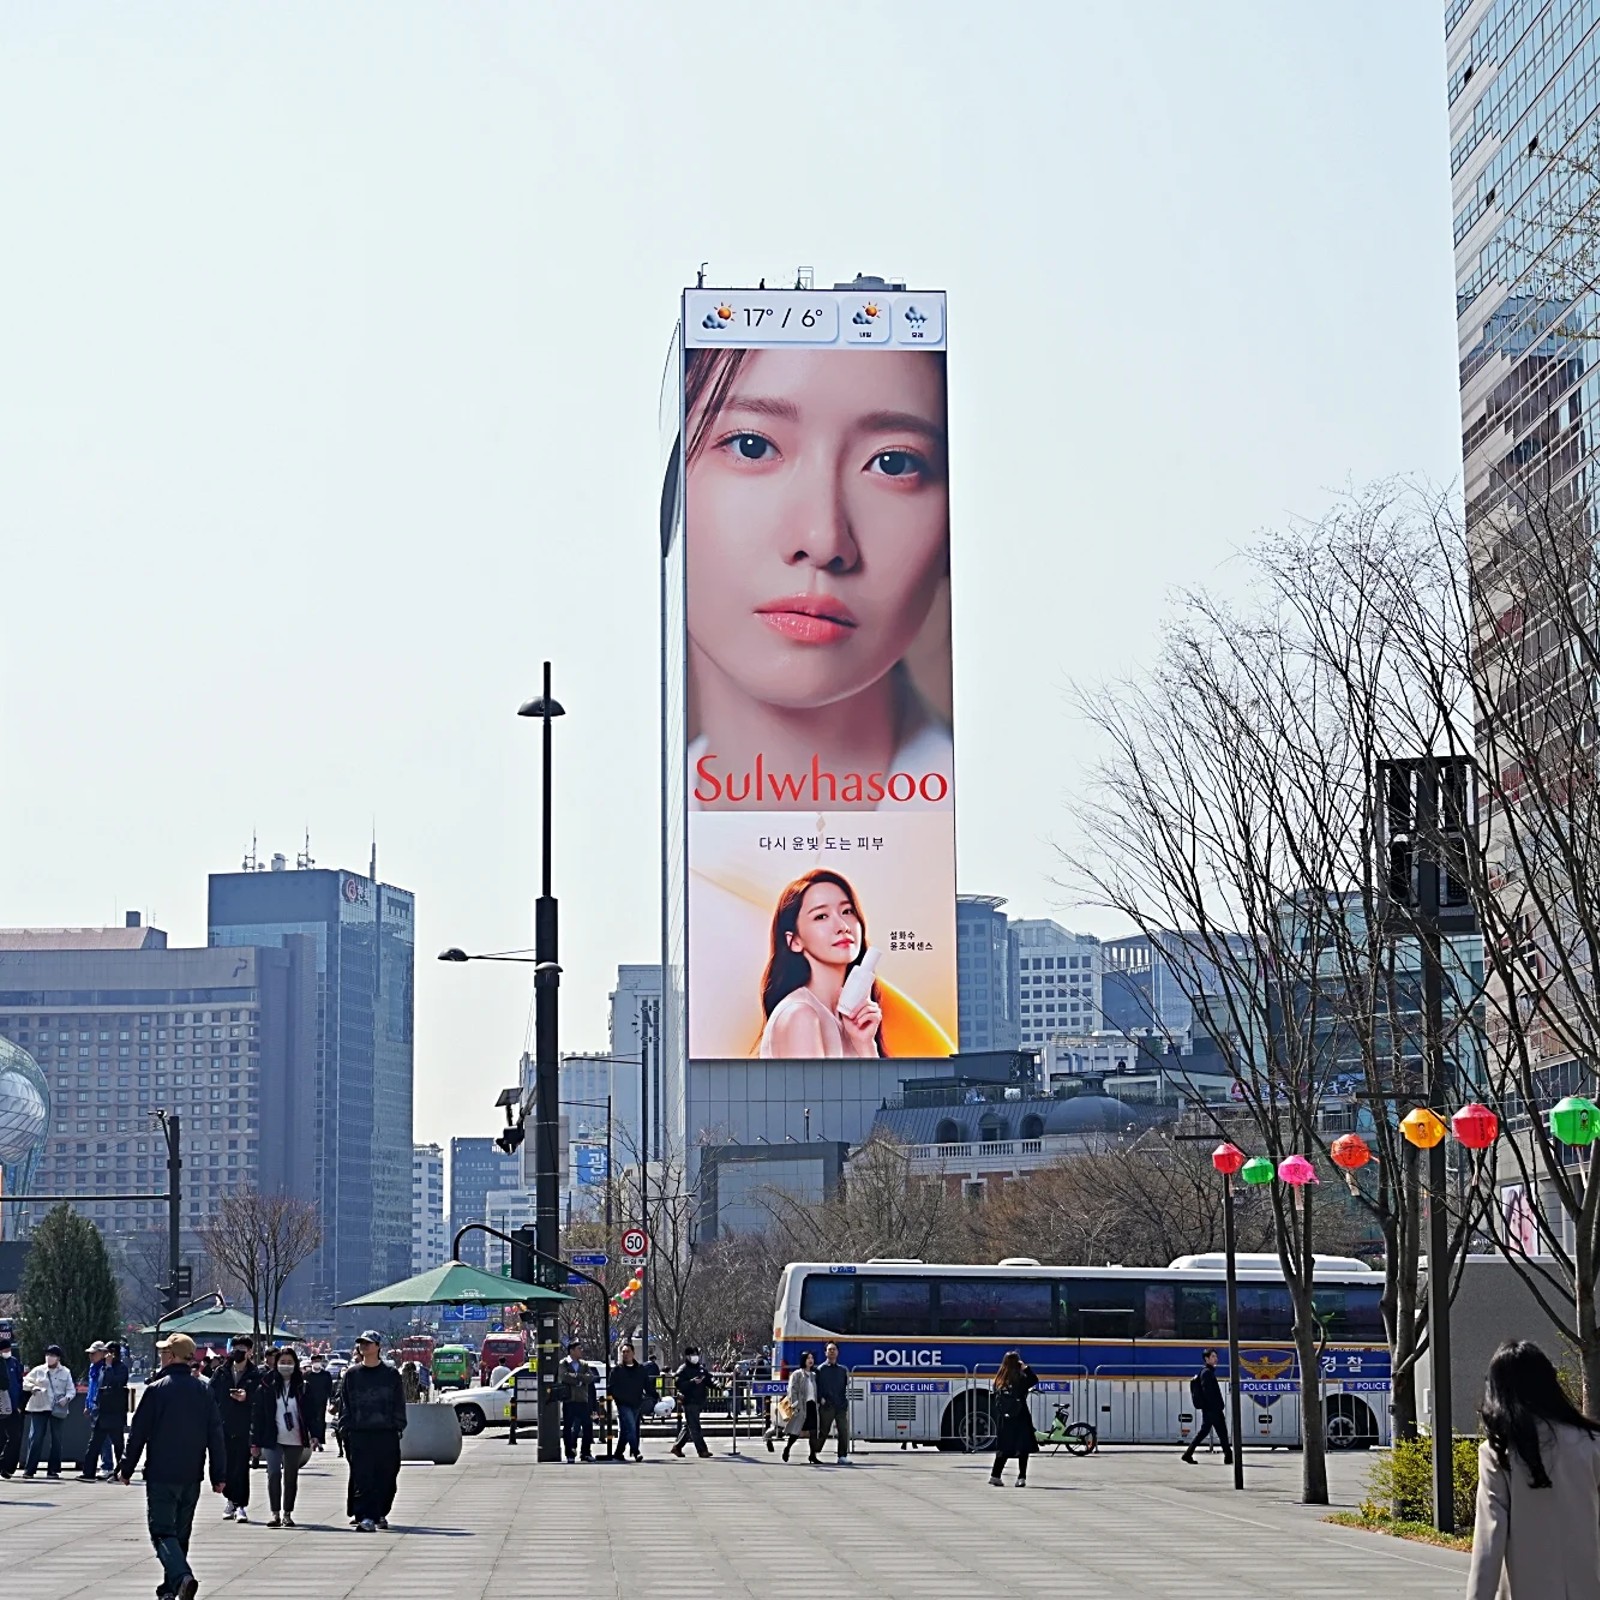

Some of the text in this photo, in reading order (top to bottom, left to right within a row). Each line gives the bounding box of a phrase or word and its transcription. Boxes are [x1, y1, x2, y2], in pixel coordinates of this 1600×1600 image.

[743, 308, 774, 328] 17°
[801, 308, 823, 328] 6°
[694, 754, 947, 802] Sulwhasoo
[759, 836, 884, 851] 다시 윤빛 도는 피부
[889, 930, 915, 940] 설화수
[889, 941, 933, 951] 윤조에센스
[626, 1235, 643, 1250] 50
[622, 1257, 645, 1265] 도심부
[873, 1349, 942, 1366] POLICE
[1321, 1355, 1364, 1373] 경찰
[885, 1382, 934, 1391] POLICE LINE
[1038, 1382, 1056, 1391] LINE
[1243, 1382, 1291, 1391] POLICE LINE
[1356, 1382, 1386, 1391] POLICE
